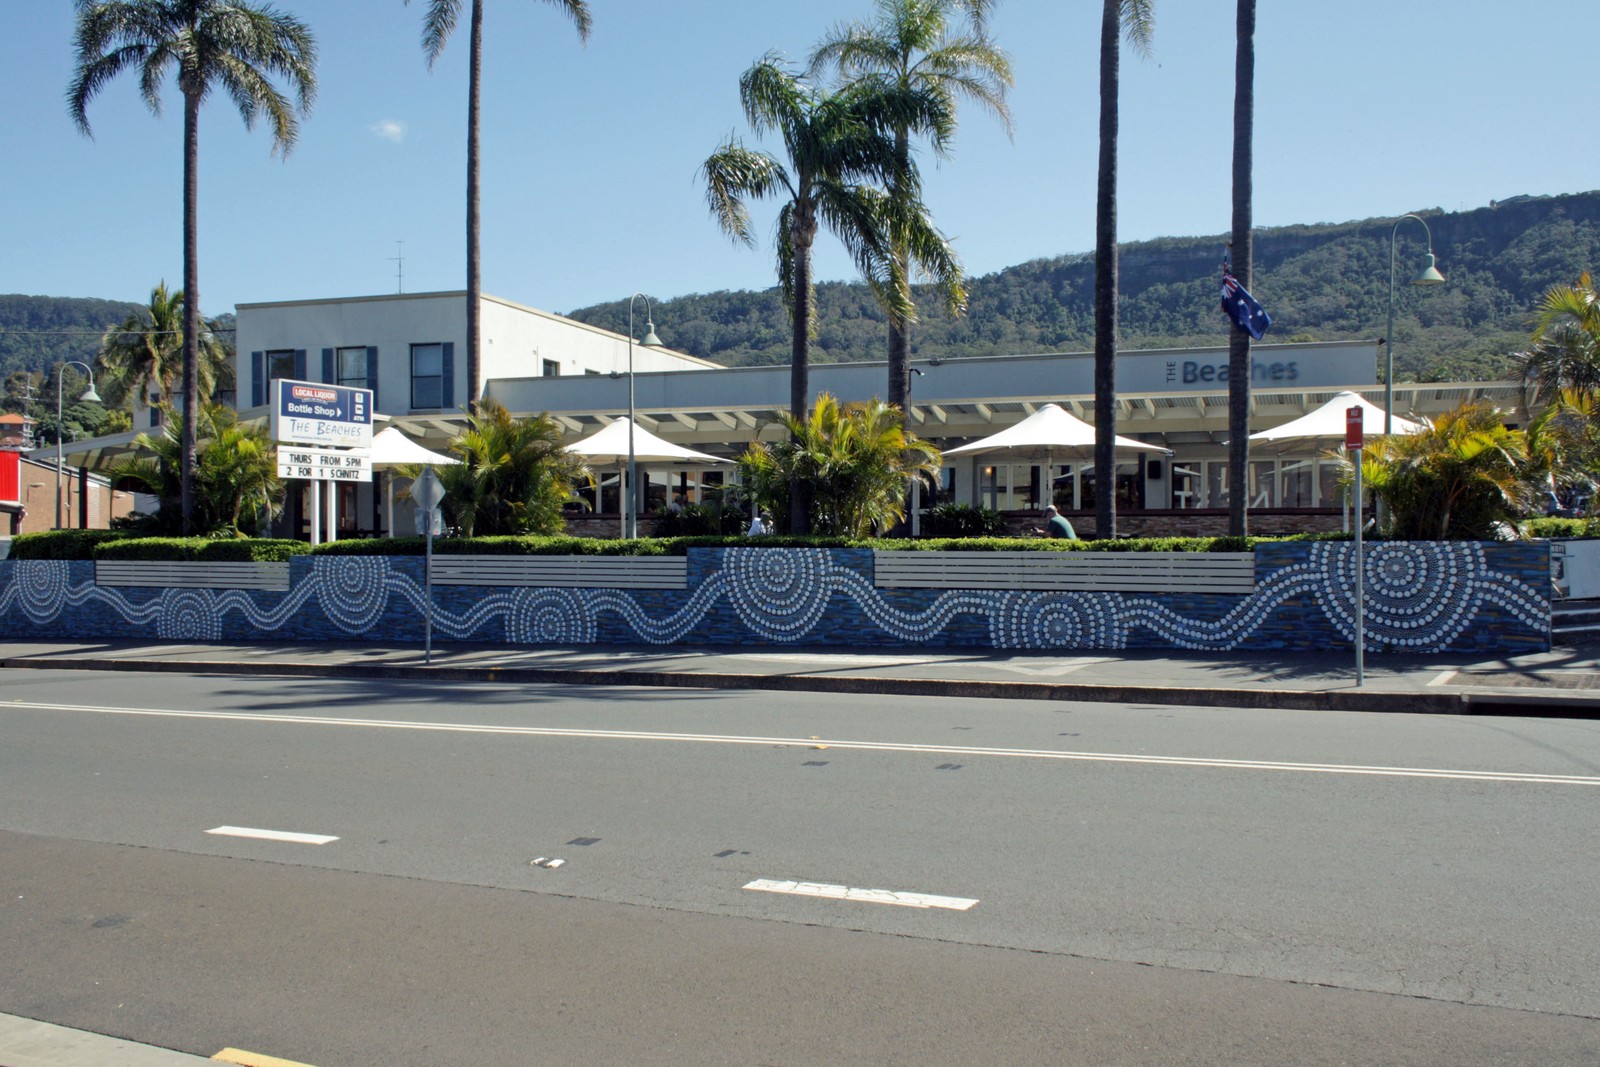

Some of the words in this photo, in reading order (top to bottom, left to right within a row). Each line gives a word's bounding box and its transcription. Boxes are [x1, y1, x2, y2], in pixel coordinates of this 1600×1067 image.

[1166, 361, 1176, 383] THE
[1182, 357, 1299, 384] Beahes
[295, 389, 314, 397] LOCAL
[314, 391, 336, 399] LIQUOR
[288, 403, 312, 414] Bottle
[314, 405, 335, 417] Shop
[317, 421, 361, 437] BEACHES
[289, 454, 312, 464] THURS
[320, 456, 340, 465] FROM
[287, 466, 291, 476] 2
[298, 467, 312, 476] FOR
[320, 469, 323, 477] 1
[330, 469, 359, 479] SCHNITZ
